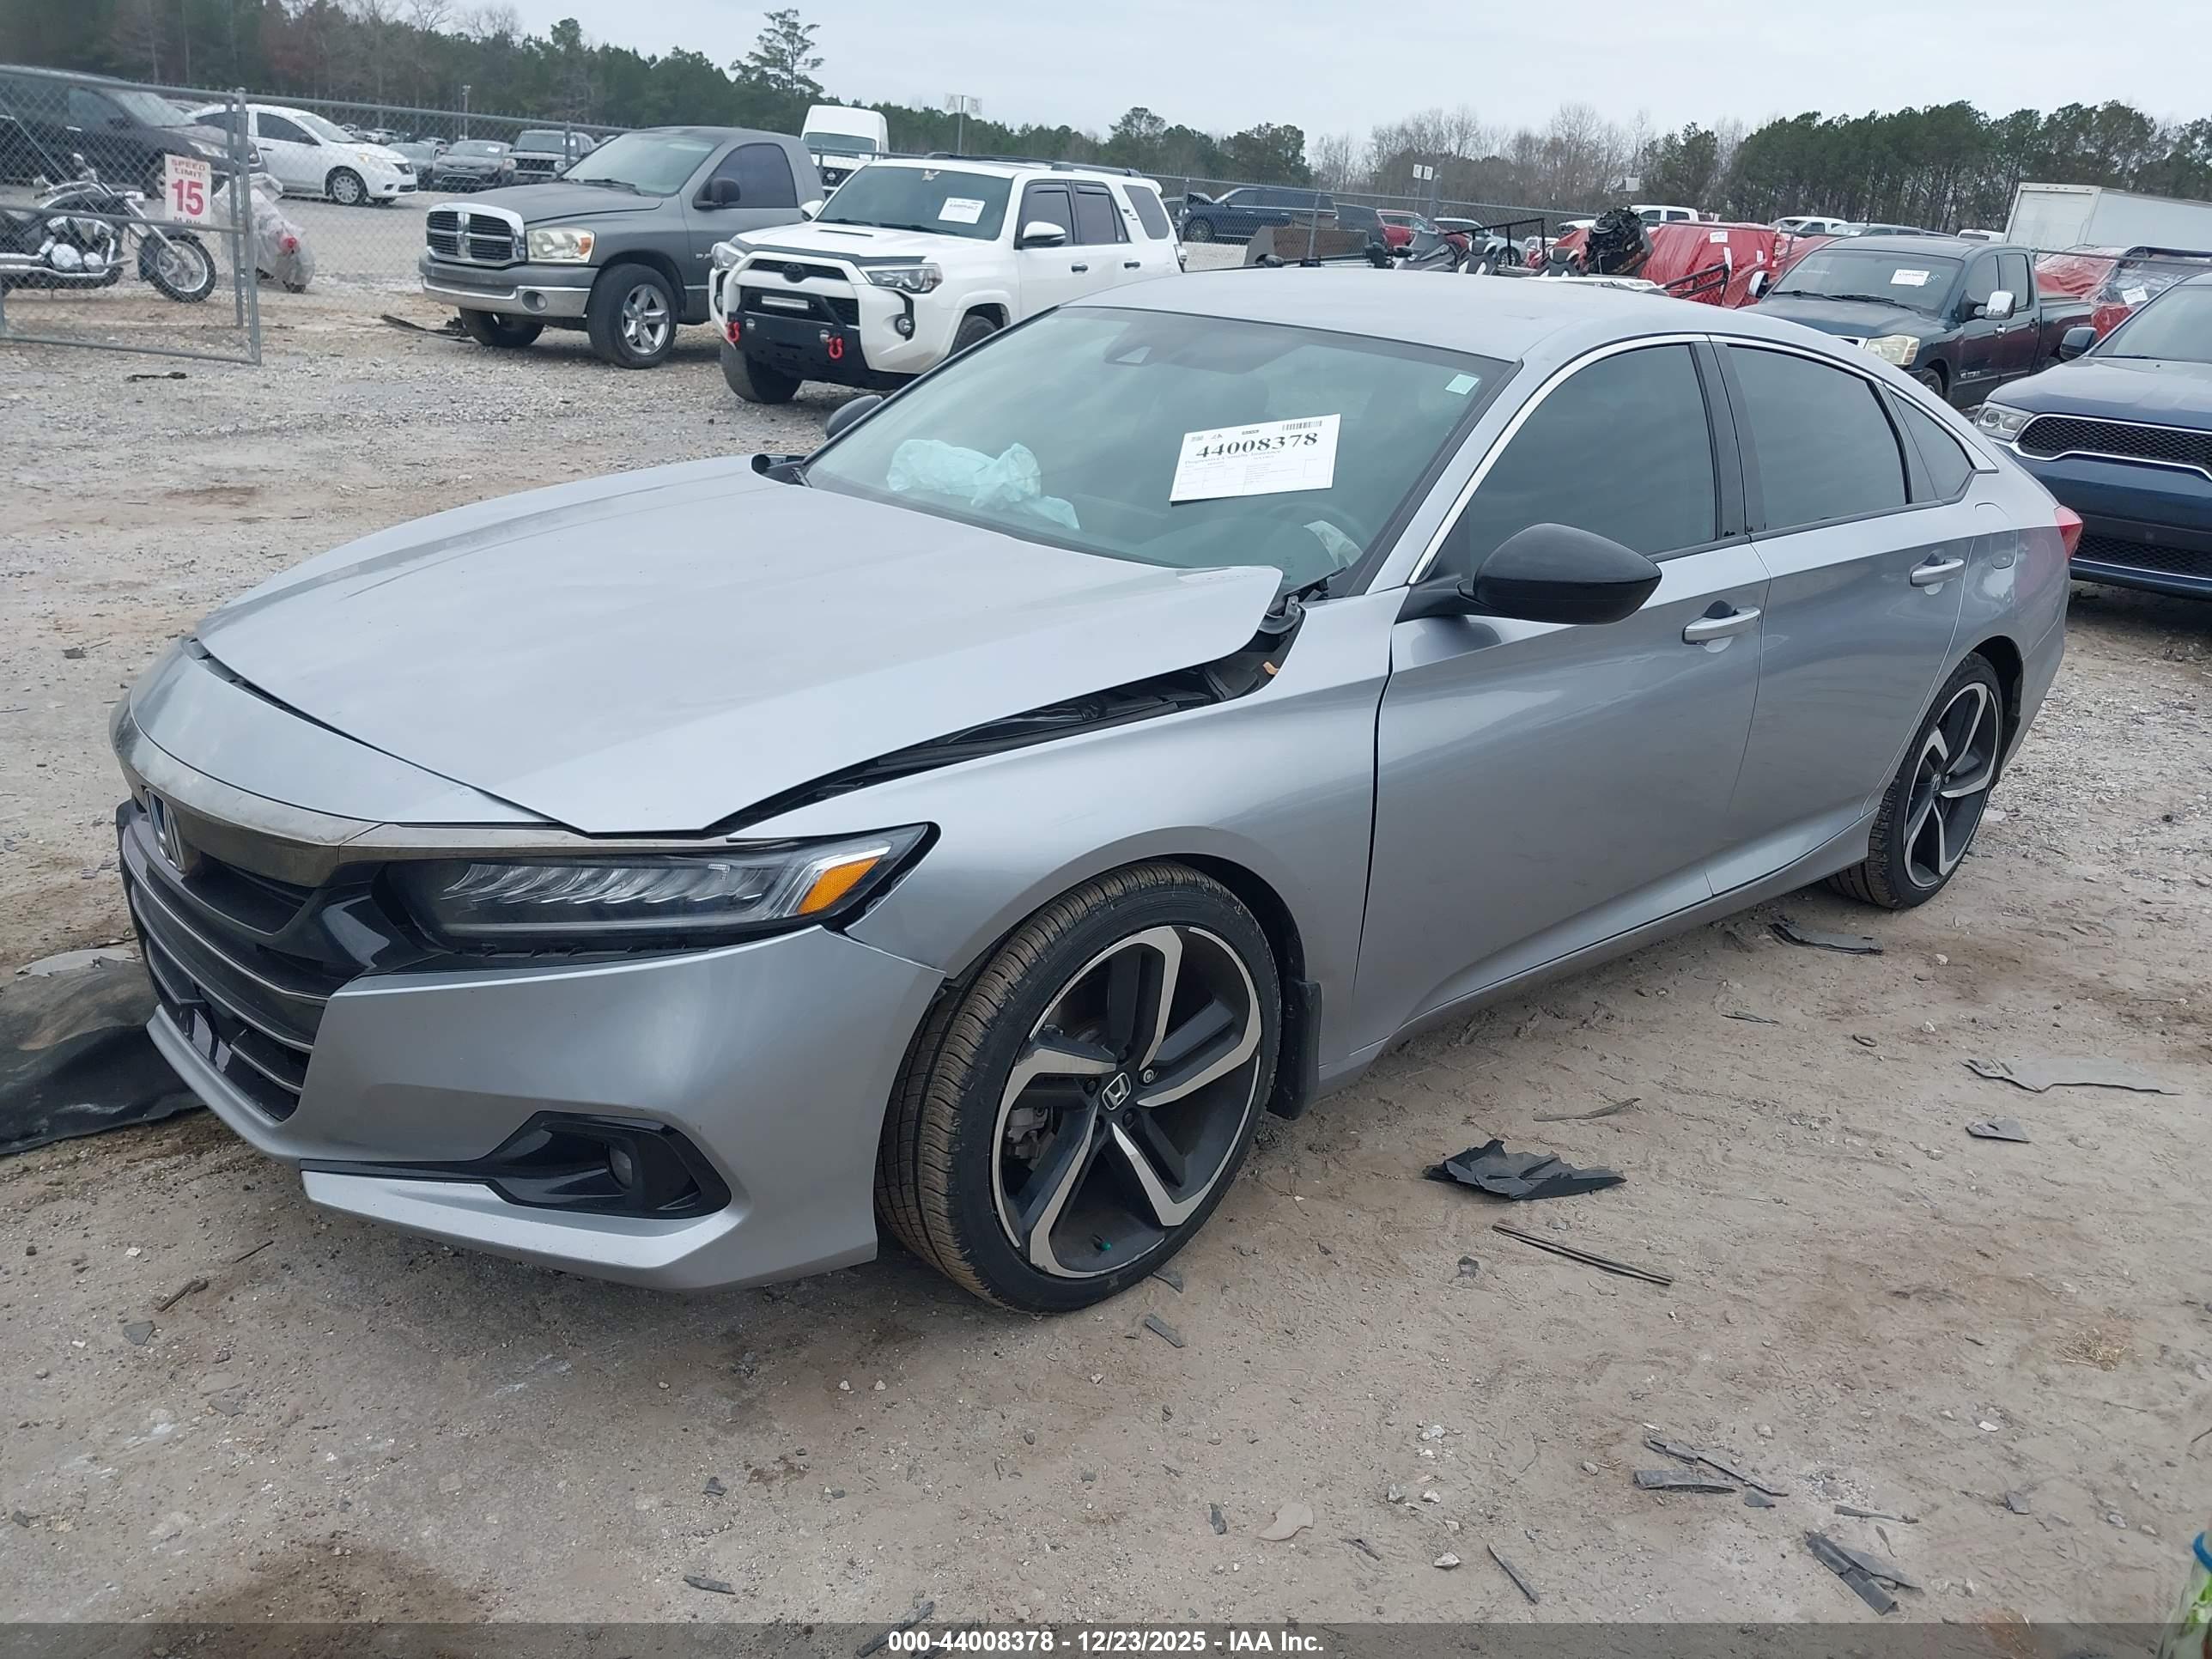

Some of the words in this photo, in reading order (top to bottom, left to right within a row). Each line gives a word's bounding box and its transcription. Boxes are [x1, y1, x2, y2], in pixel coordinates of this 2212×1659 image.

[946, 95, 957, 111] A
[970, 99, 980, 112] B
[171, 159, 206, 172] SPEED
[174, 167, 204, 179] LIMIT
[172, 179, 204, 216] 15
[1196, 432, 1318, 458] 44008378
